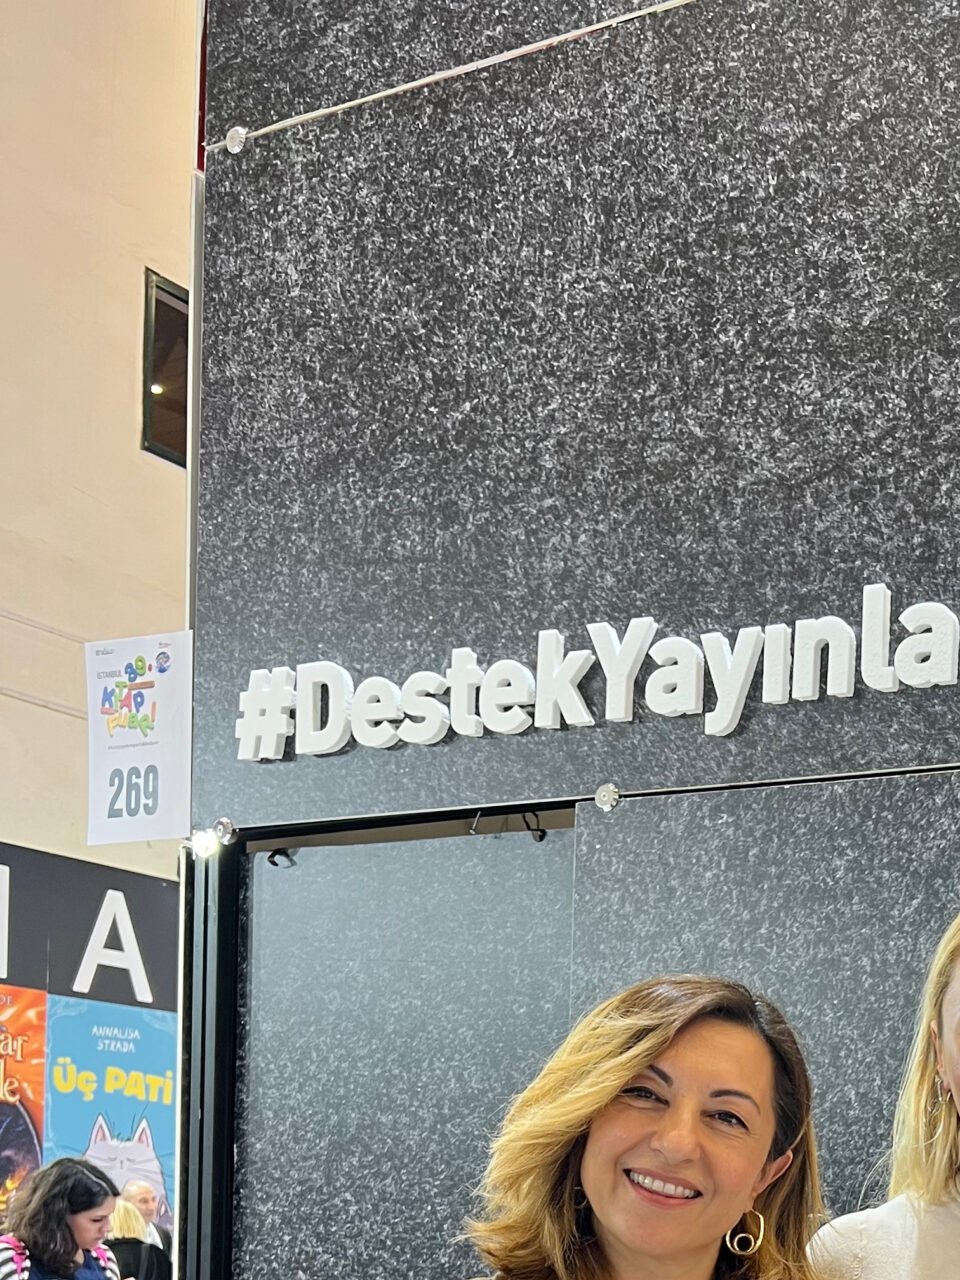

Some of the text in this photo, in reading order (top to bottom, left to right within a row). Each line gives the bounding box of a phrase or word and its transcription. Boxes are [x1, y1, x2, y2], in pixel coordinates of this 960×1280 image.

[107, 764, 159, 819] 269
[53, 1056, 173, 1105] ÜÇ PATİ
